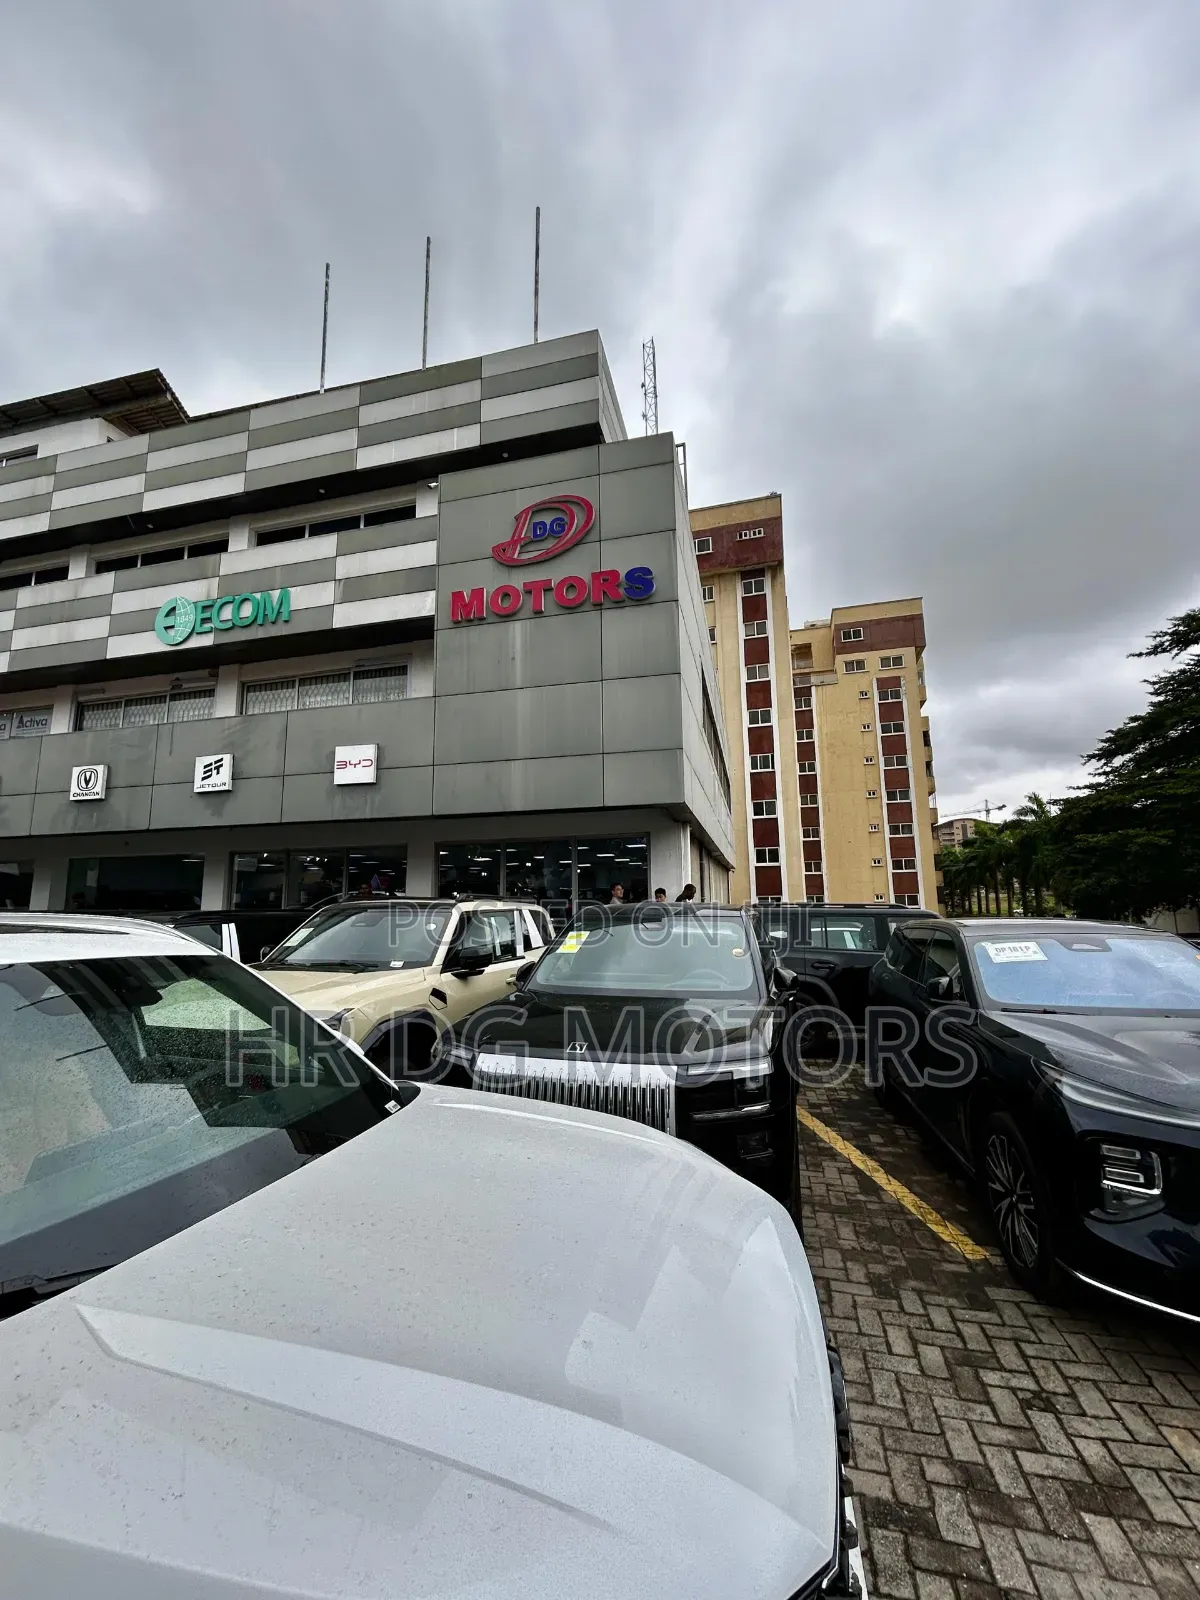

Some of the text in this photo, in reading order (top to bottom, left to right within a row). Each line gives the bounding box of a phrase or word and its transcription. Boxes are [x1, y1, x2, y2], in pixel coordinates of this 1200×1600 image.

[532, 516, 567, 540] DG
[450, 566, 655, 623] MOTORS
[194, 587, 291, 634] ECOM
[176, 615, 194, 623] 1849
[16, 715, 48, 729] Activa
[335, 758, 374, 770] BYD
[196, 781, 227, 789] JETOUR
